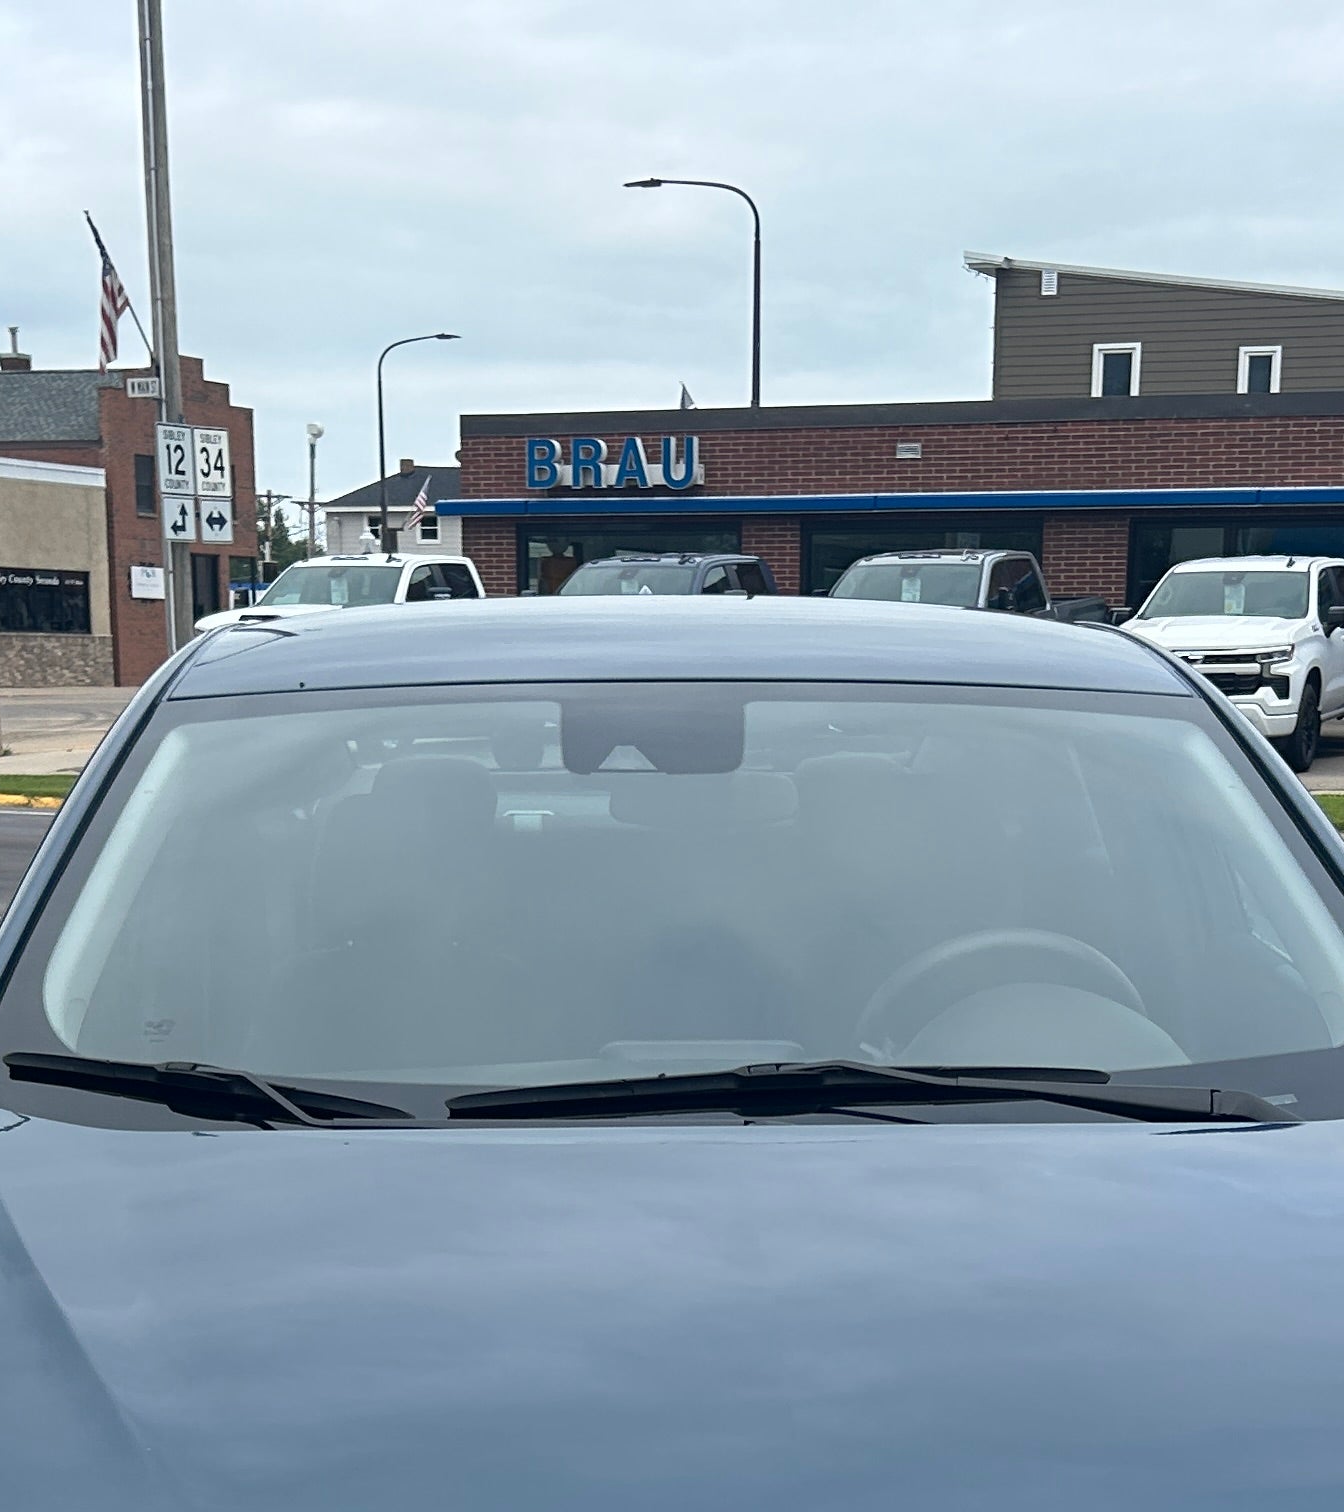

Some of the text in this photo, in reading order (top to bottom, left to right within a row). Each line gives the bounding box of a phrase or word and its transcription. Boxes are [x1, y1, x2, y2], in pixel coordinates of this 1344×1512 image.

[162, 429, 186, 441] SIBLEY
[199, 433, 222, 445] SIBLEY
[166, 443, 186, 476] 12
[200, 446, 225, 479] 34
[526, 436, 699, 490] BRAU
[164, 478, 190, 490] COUNTY
[201, 481, 226, 492] COUNTY
